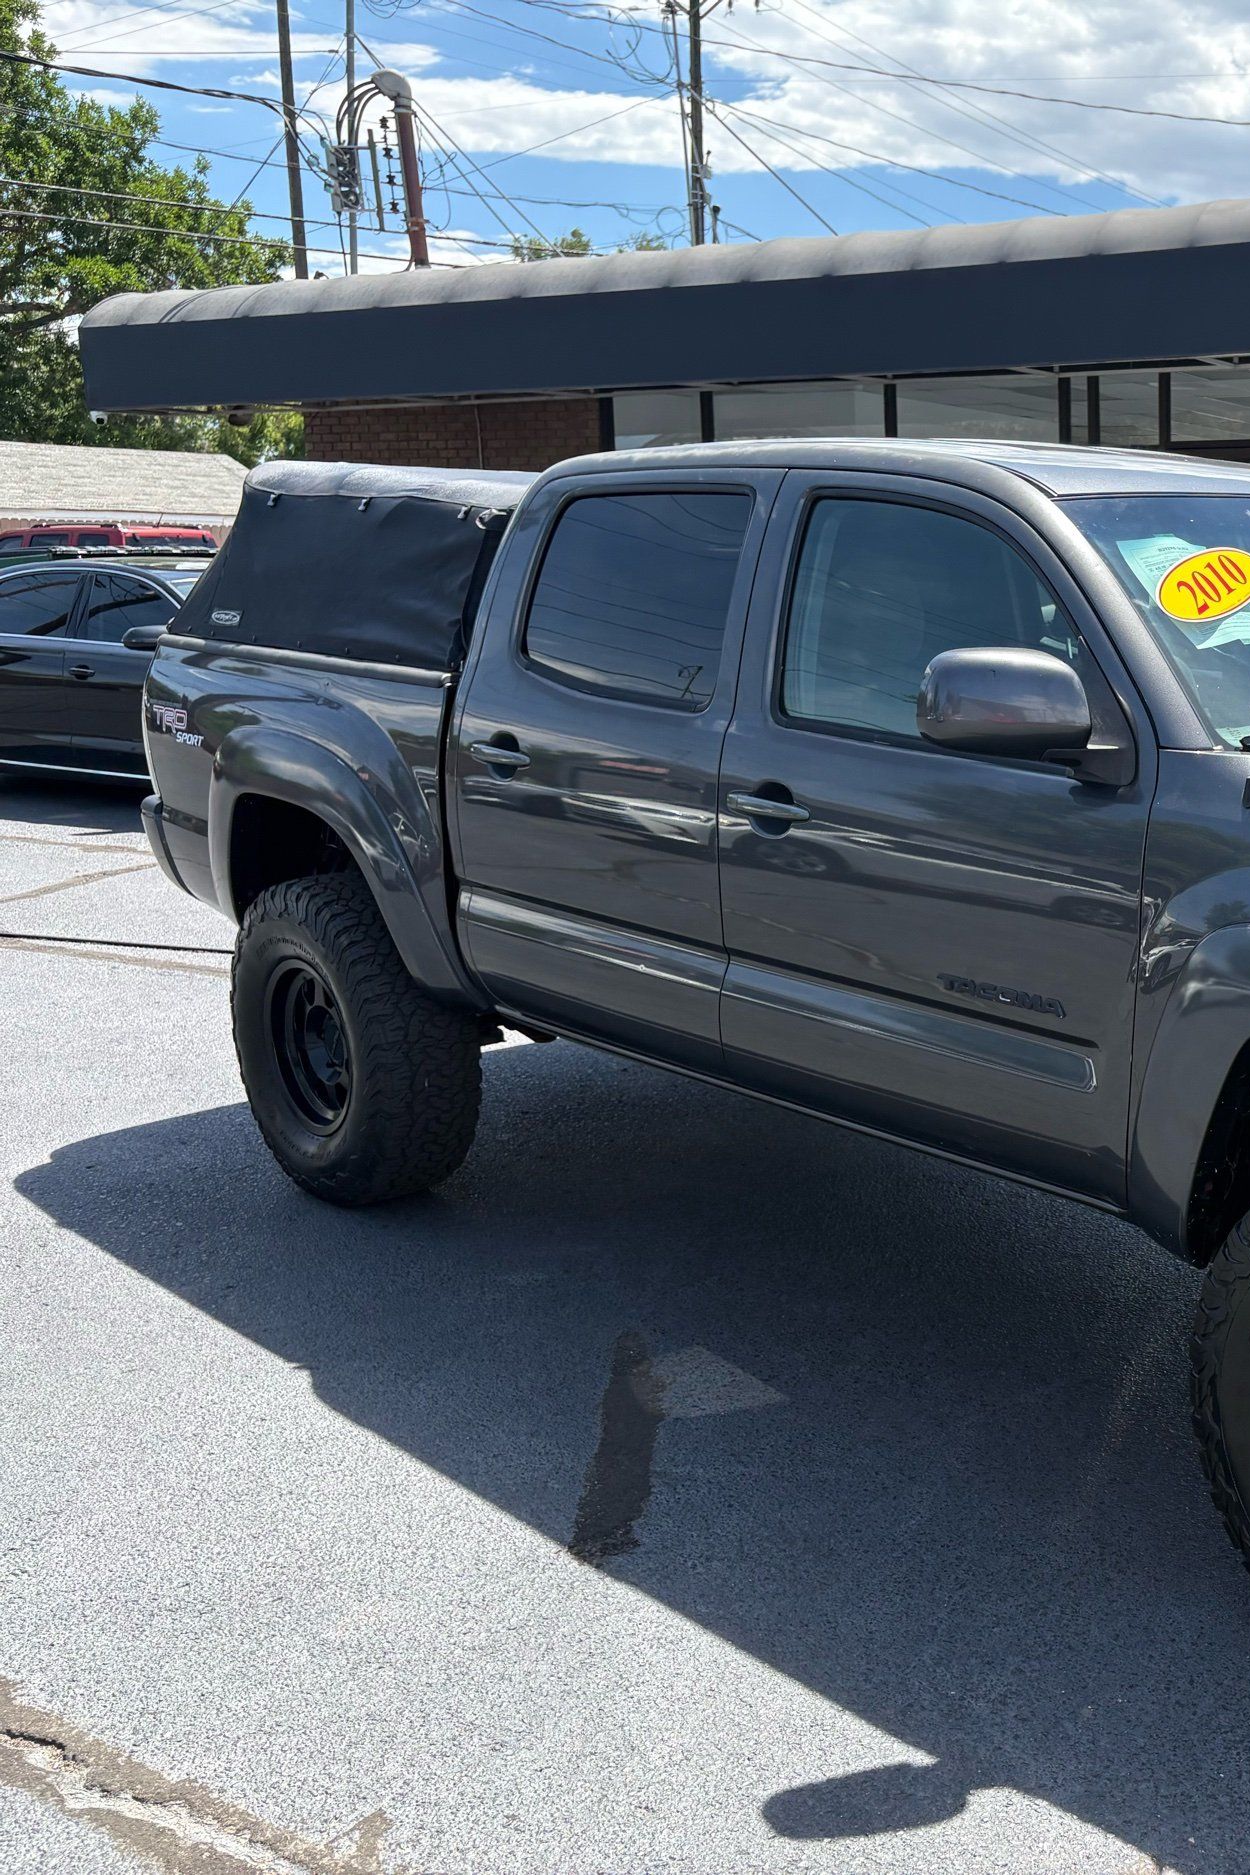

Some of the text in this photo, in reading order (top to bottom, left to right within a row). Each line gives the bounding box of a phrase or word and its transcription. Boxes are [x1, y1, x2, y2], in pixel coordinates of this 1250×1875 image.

[1176, 554, 1247, 616] 2010
[152, 704, 188, 734] TRD
[175, 731, 205, 747] SPORT
[936, 973, 1066, 1019] TACOMA
